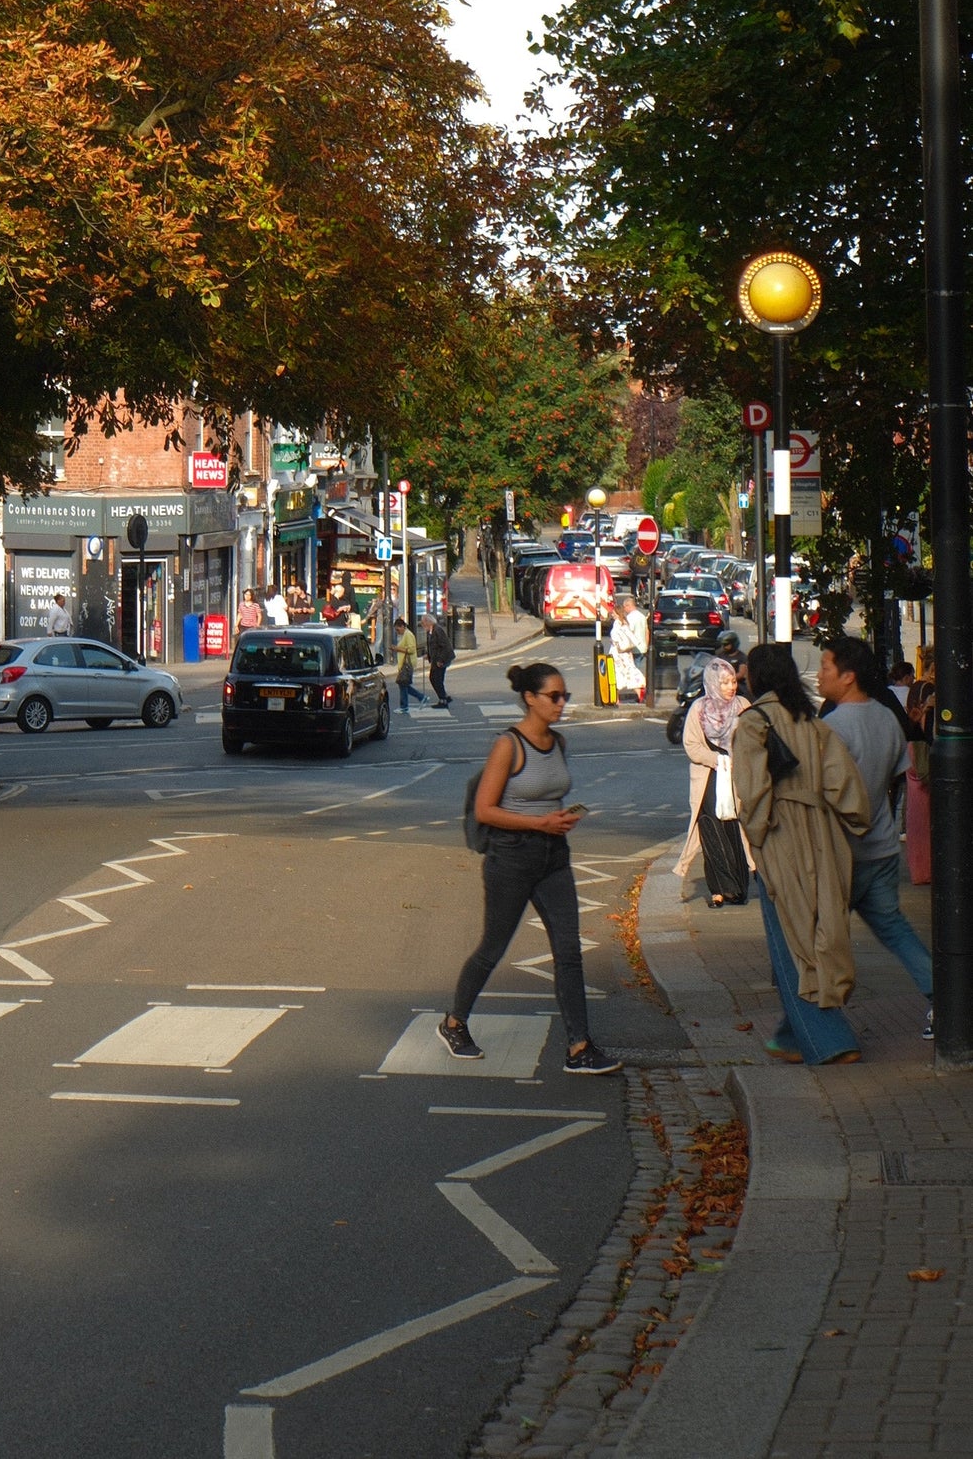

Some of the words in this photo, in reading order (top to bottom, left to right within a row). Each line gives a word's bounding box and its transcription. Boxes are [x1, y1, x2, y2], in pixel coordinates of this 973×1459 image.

[749, 404, 768, 426] D
[196, 470, 224, 481] NEWS
[8, 503, 68, 516] Convenience
[70, 505, 96, 517] Store
[111, 505, 148, 517] HEATH
[151, 504, 184, 516] NEWS
[21, 567, 35, 578] WE
[36, 567, 70, 580] DELIVER
[20, 584, 71, 597] NEWSPAPER
[30, 598, 36, 610] &
[19, 616, 37, 627] 0207
